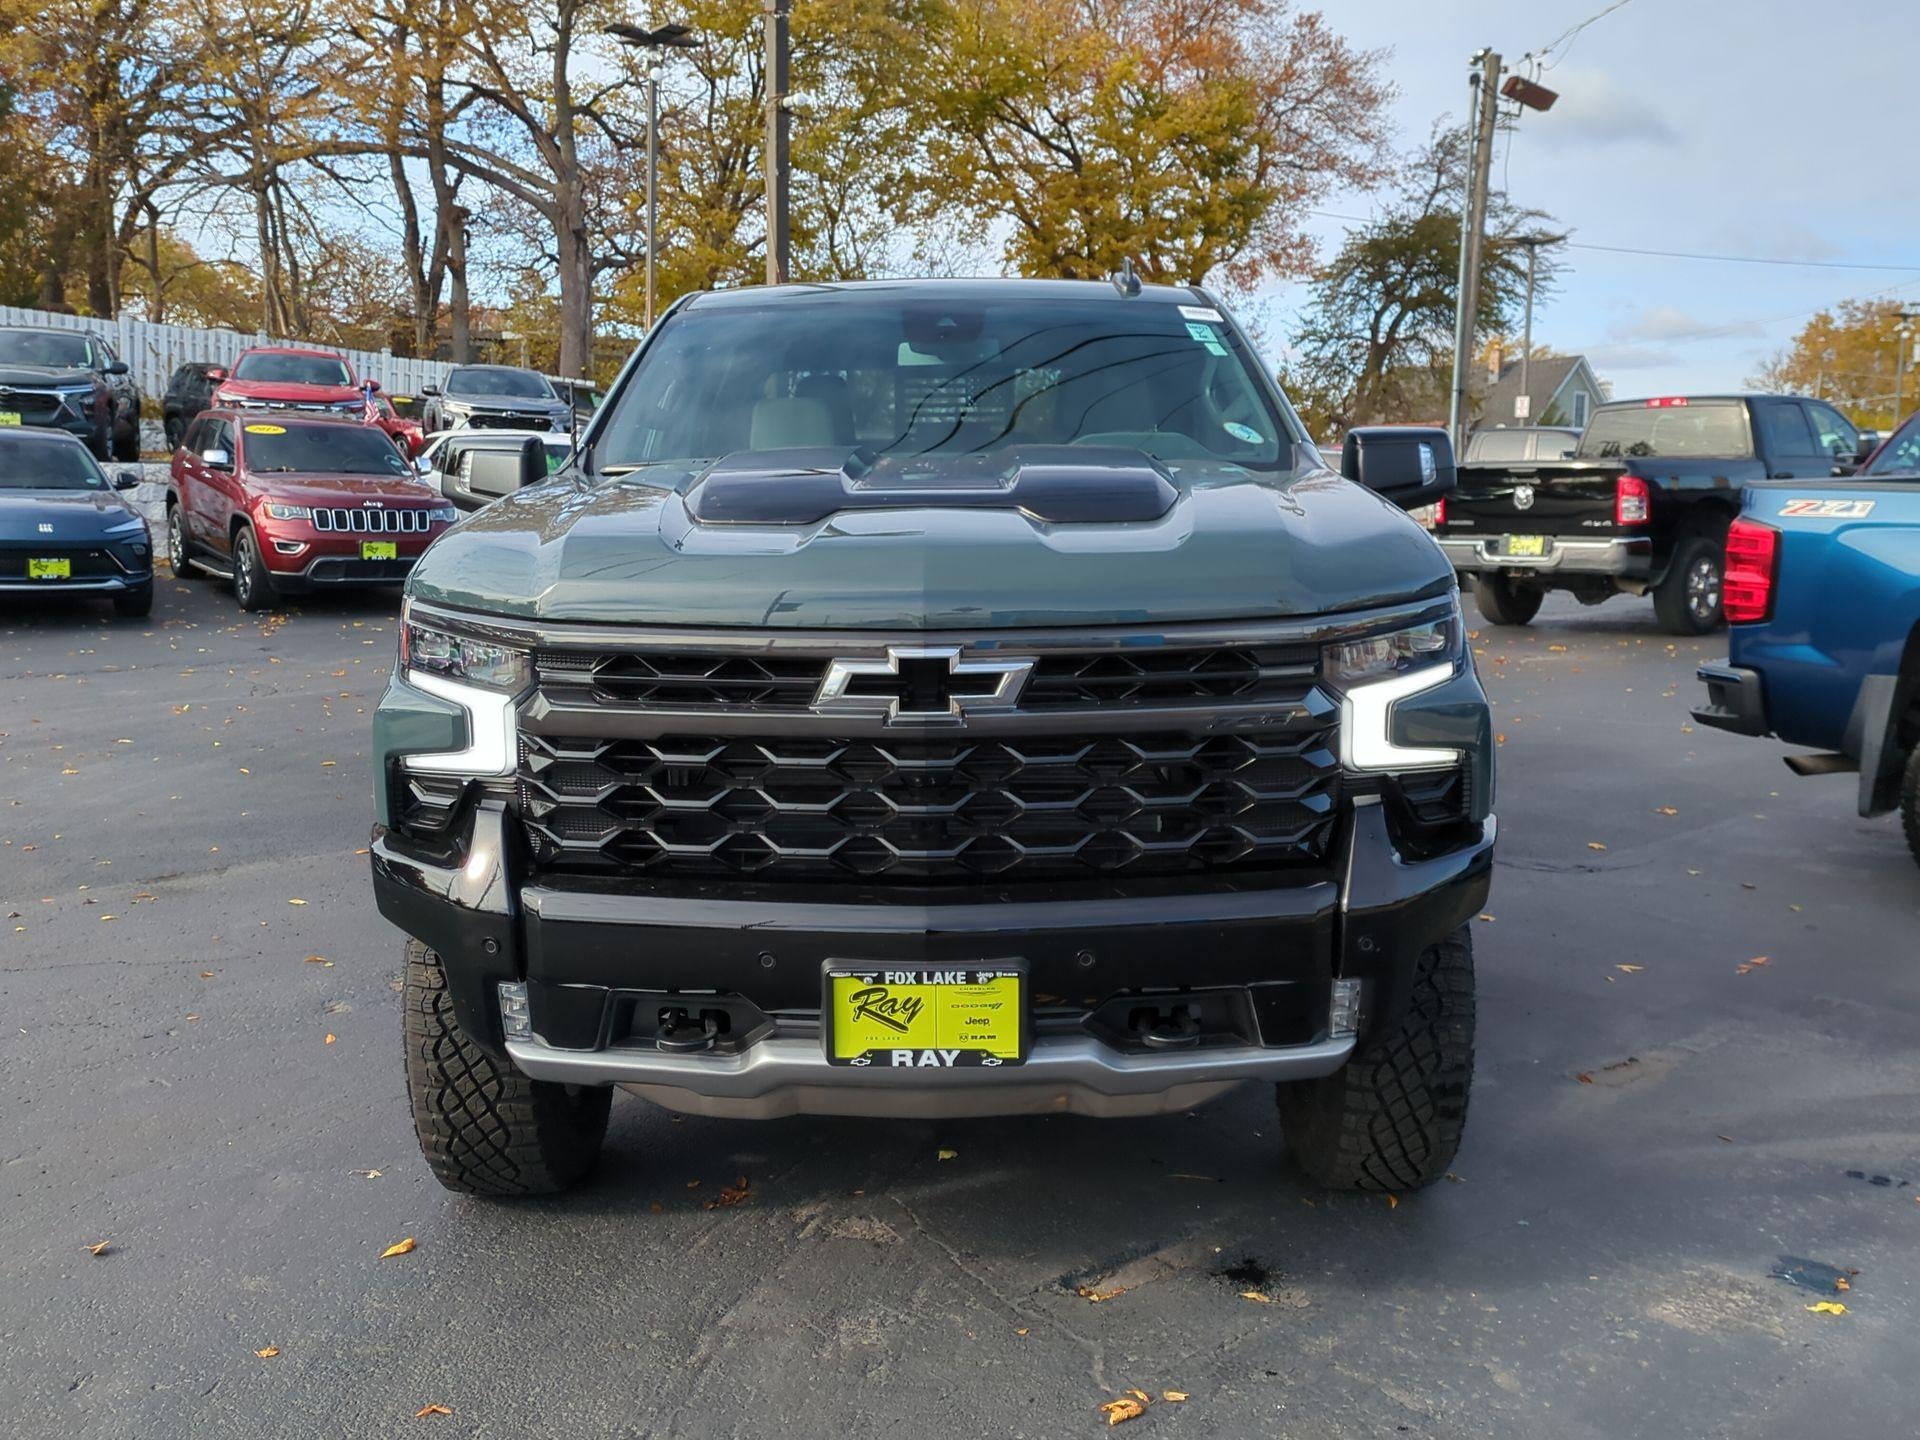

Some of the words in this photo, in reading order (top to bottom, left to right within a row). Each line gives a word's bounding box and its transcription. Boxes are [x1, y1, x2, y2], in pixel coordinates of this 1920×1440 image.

[885, 971, 917, 985] FOX
[922, 971, 967, 985] LAKE
[849, 987, 925, 1034] Ray
[965, 1016, 990, 1026] Jeep
[891, 1049, 961, 1067] RAY
